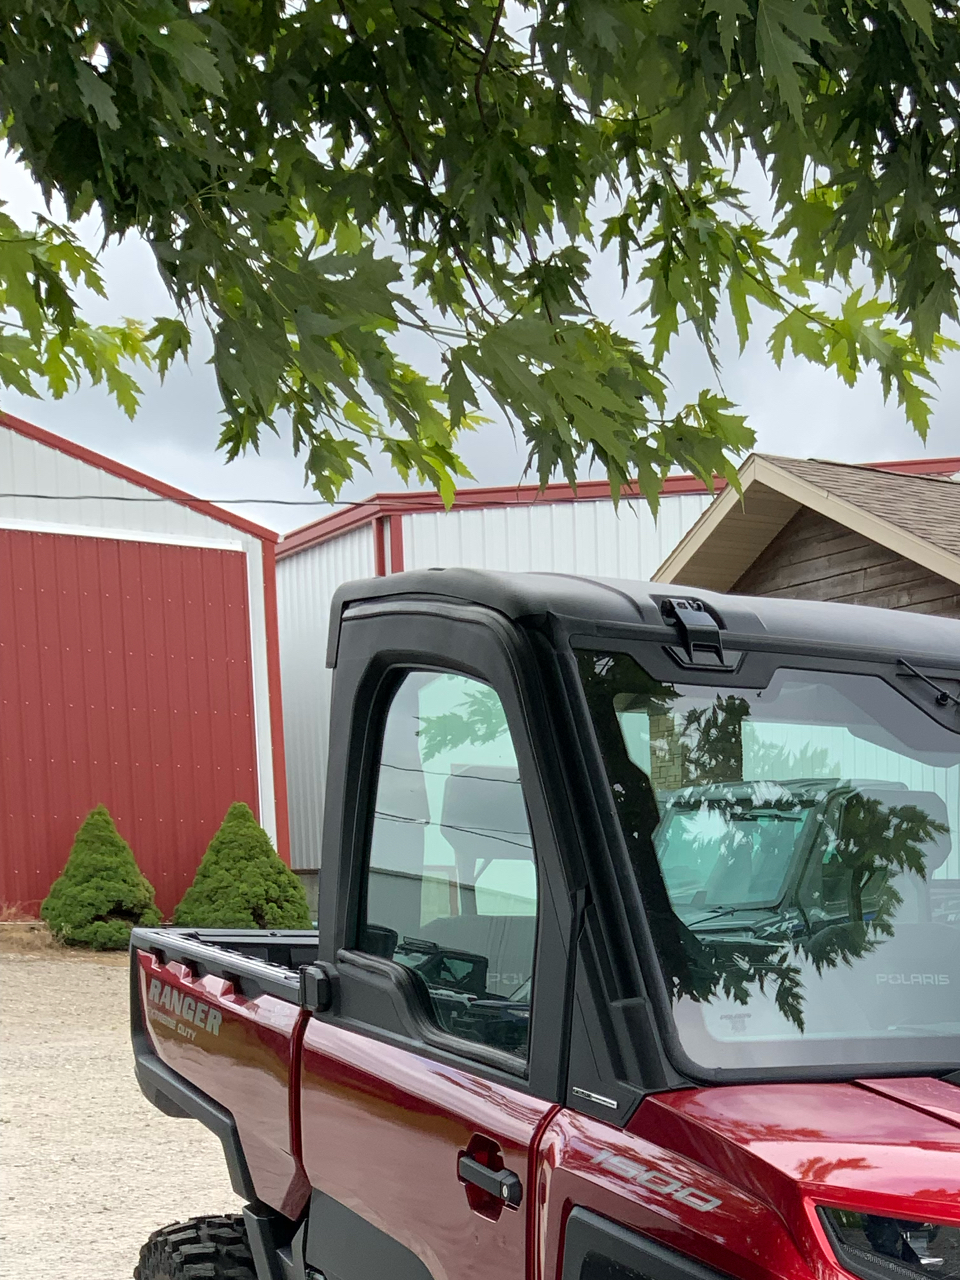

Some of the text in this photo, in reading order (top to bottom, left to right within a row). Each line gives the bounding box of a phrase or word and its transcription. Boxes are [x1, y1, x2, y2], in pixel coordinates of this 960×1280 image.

[875, 973, 950, 985] POLARIS
[146, 1006, 197, 1041] EXTREME DUTY
[148, 978, 222, 1037] RANGER
[590, 1149, 722, 1212] 1500
